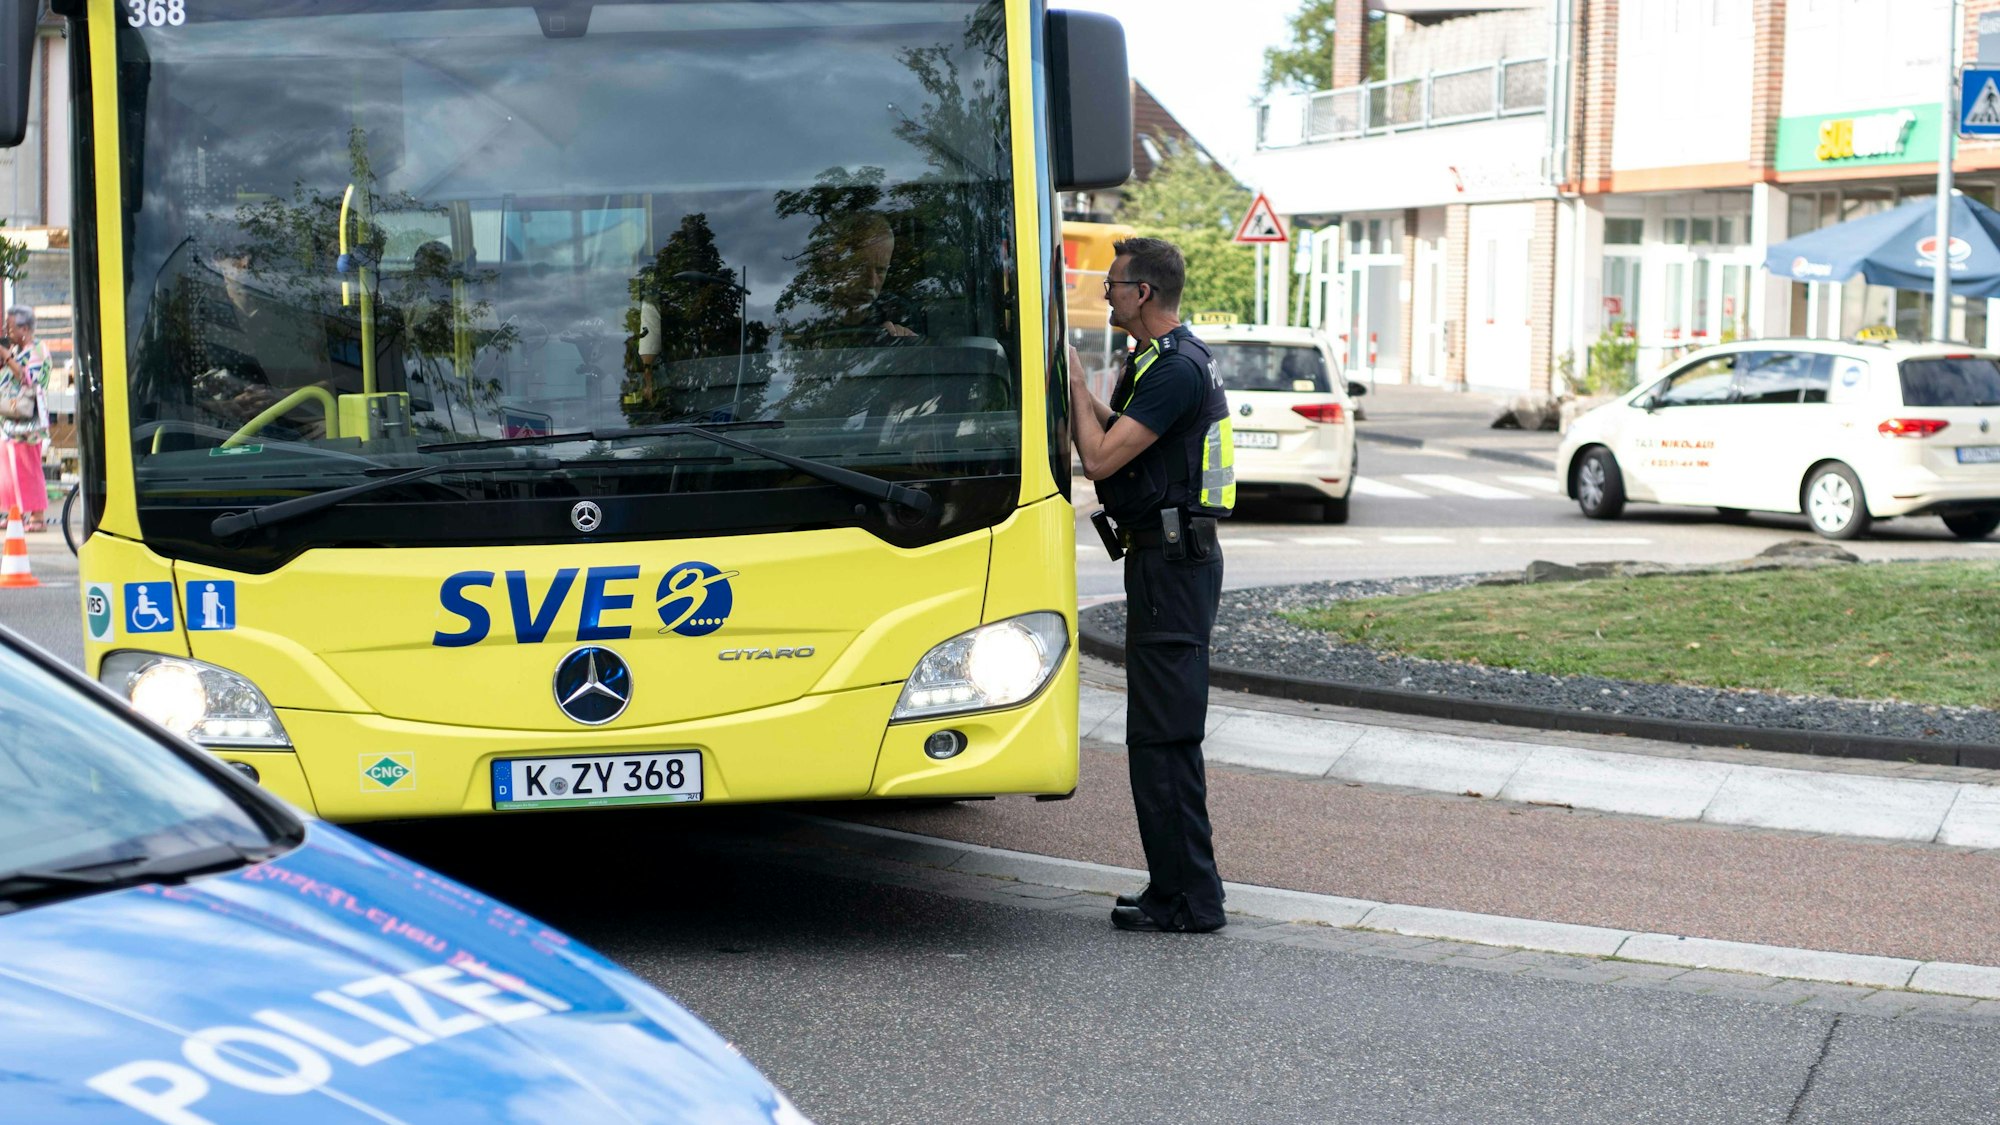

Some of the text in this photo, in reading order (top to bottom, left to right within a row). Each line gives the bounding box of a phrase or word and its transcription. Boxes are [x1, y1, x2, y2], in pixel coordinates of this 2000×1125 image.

[128, 0, 186, 27] 368
[1816, 110, 1916, 160] SUB
[87, 596, 102, 613] VRS
[432, 564, 641, 648] SVE
[718, 646, 816, 662] CITARO
[371, 765, 404, 779] CNG
[526, 758, 686, 797] K ZY 368
[499, 784, 508, 796] D
[85, 960, 572, 1125] POLIZEI
